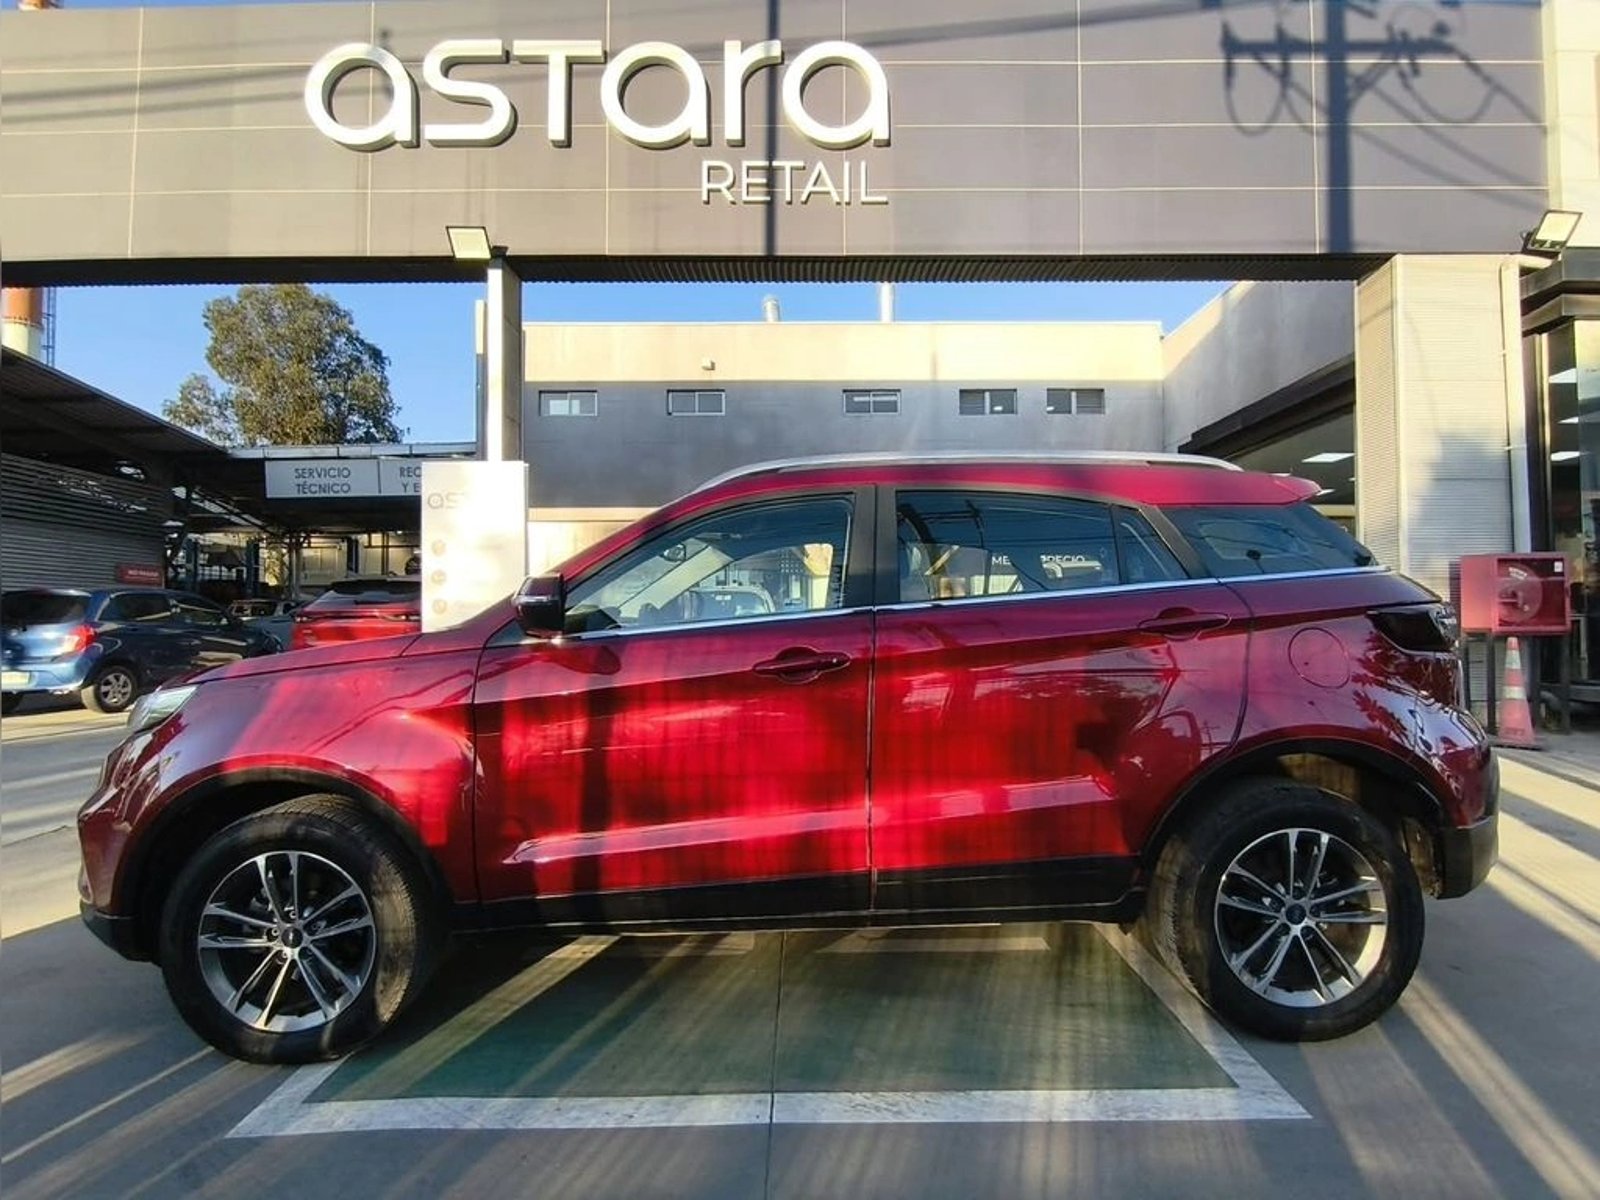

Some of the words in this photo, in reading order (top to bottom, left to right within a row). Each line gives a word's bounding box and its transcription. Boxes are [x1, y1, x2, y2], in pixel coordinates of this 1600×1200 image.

[701, 159, 890, 206] RETAIL
[294, 467, 351, 479] SERVICIO
[296, 481, 351, 494] TÉCNICO
[402, 483, 410, 493] Y
